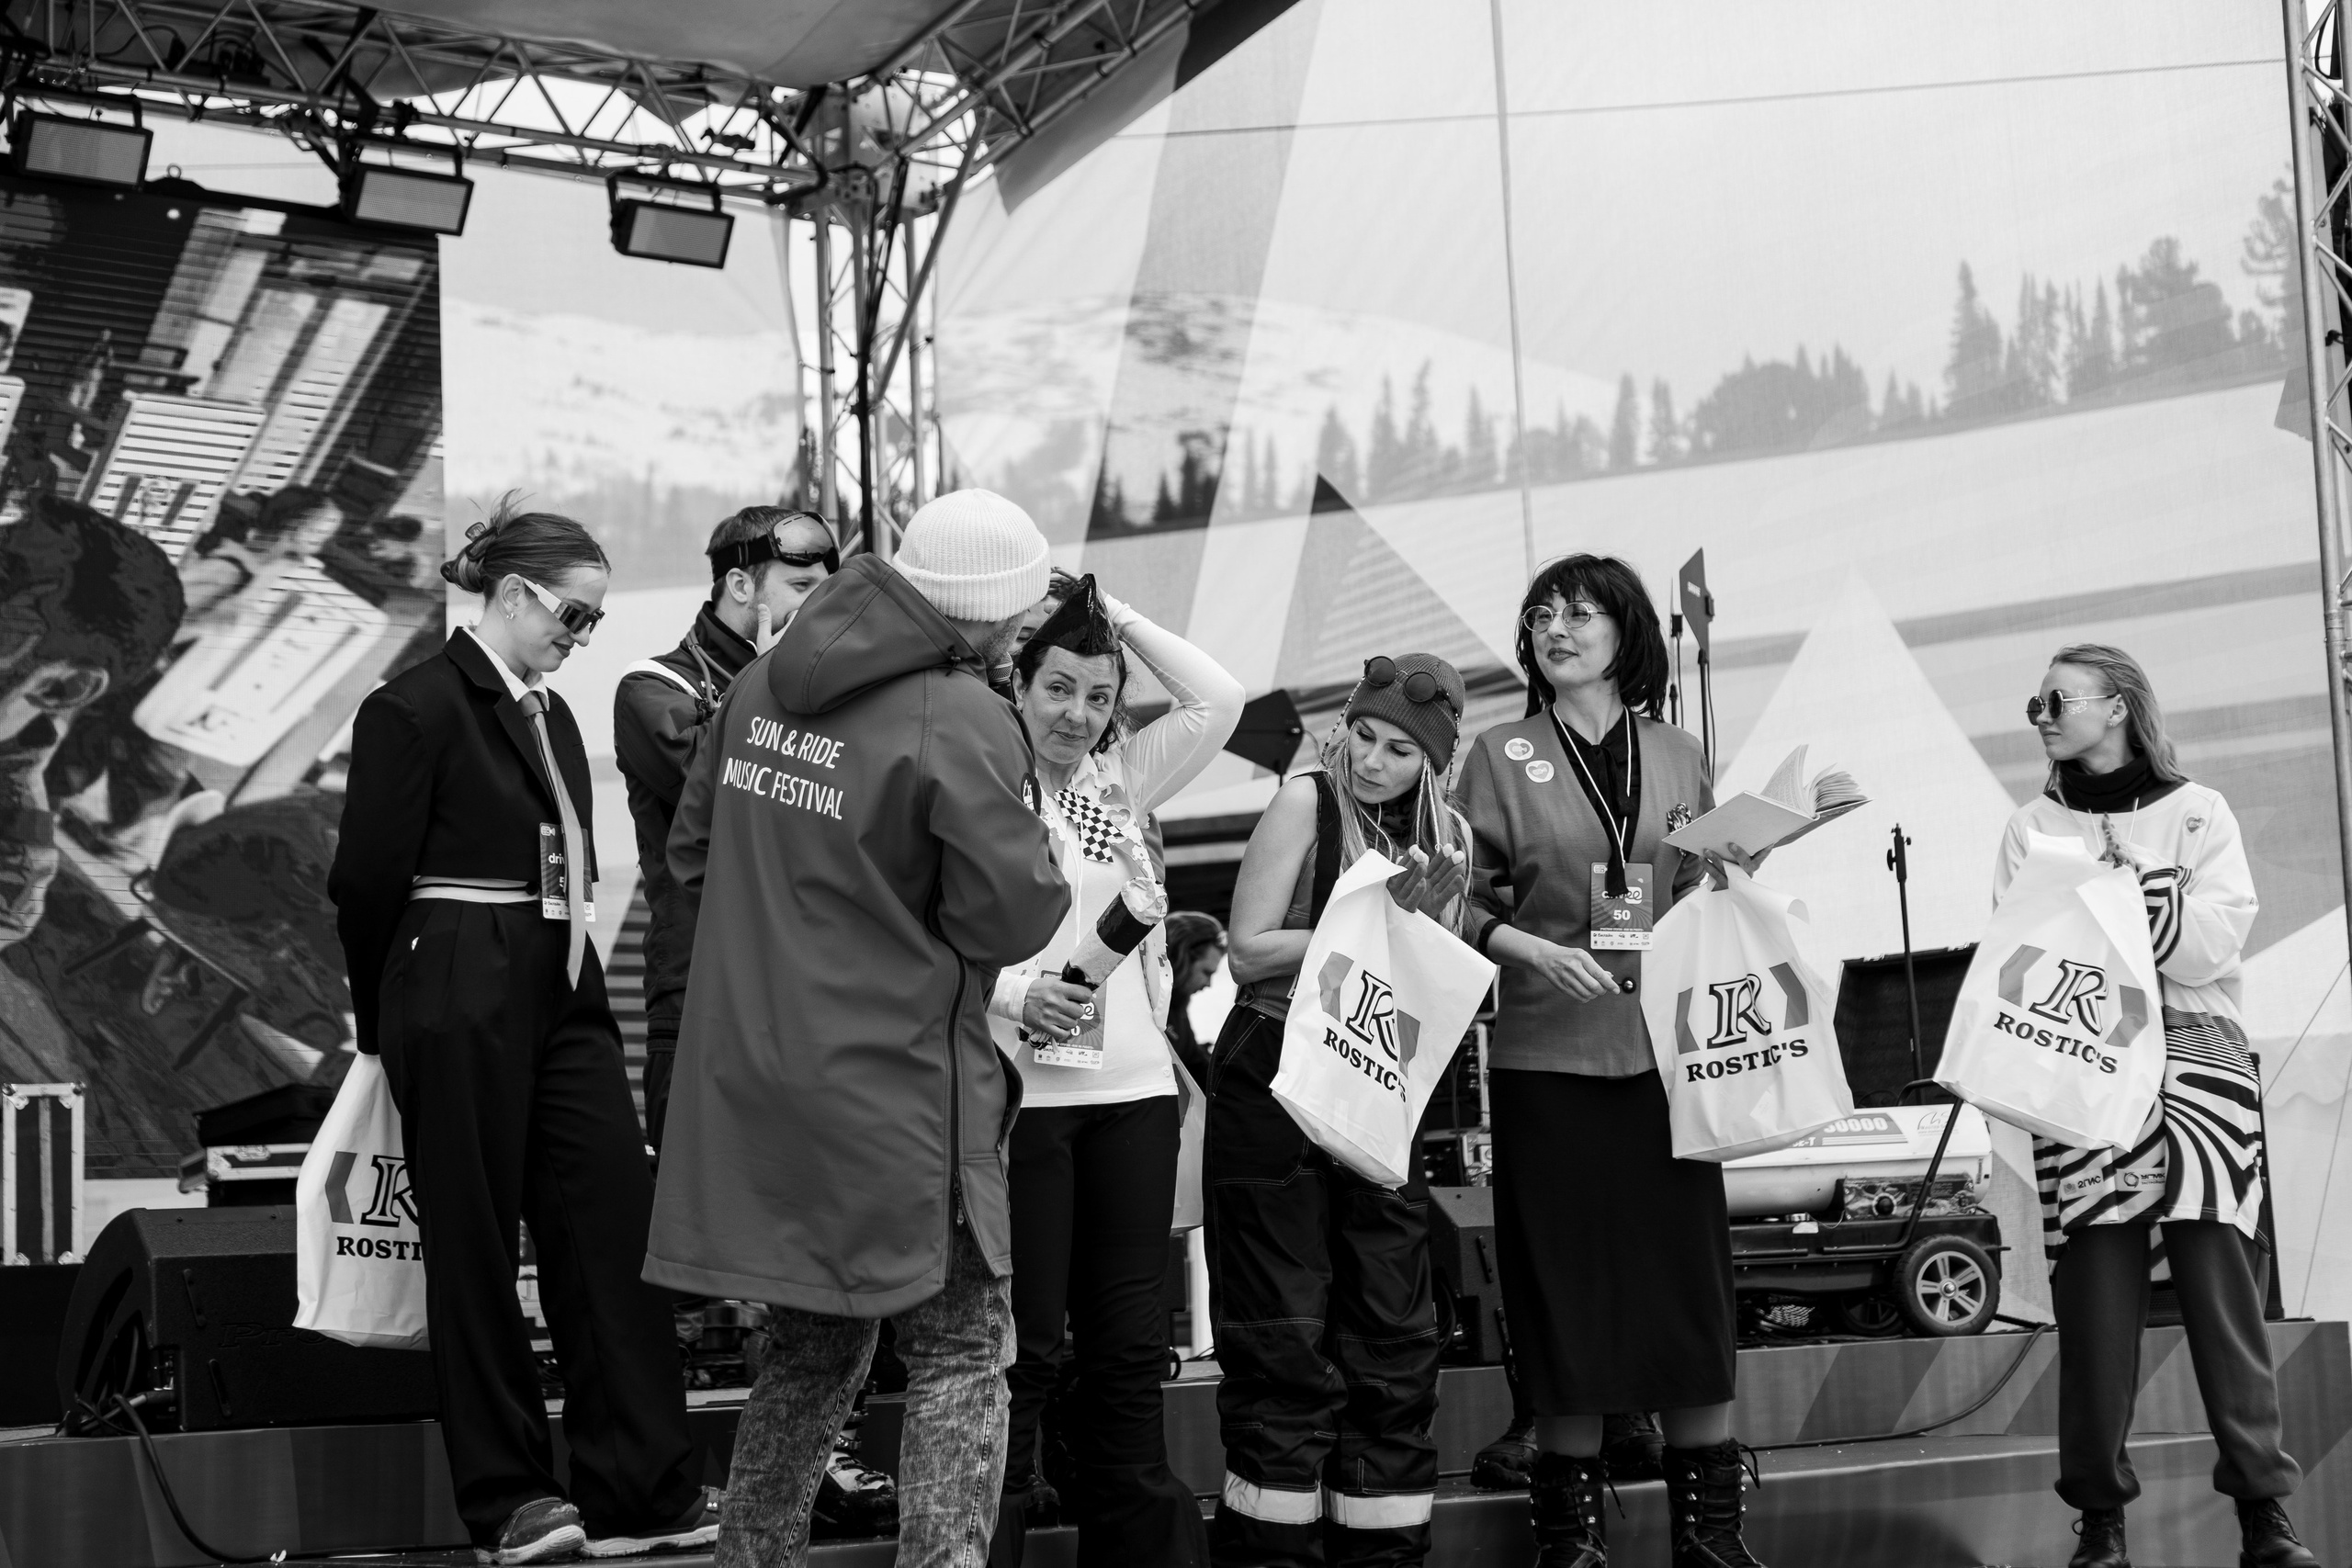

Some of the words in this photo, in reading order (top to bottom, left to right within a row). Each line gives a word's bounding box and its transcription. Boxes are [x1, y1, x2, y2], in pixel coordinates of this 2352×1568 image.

[746, 716, 784, 751] SUN
[781, 729, 797, 757] &
[797, 732, 844, 769] RIDE
[722, 757, 772, 795] MUSIC
[771, 771, 843, 820] FESTIVAL
[1612, 909, 1631, 920] 50
[1686, 1039, 1808, 1082] ROSTIC'S
[1994, 1011, 2118, 1074] ROSTIC'S
[336, 1236, 422, 1261] ROSTI
[219, 1323, 343, 1348] Pro
